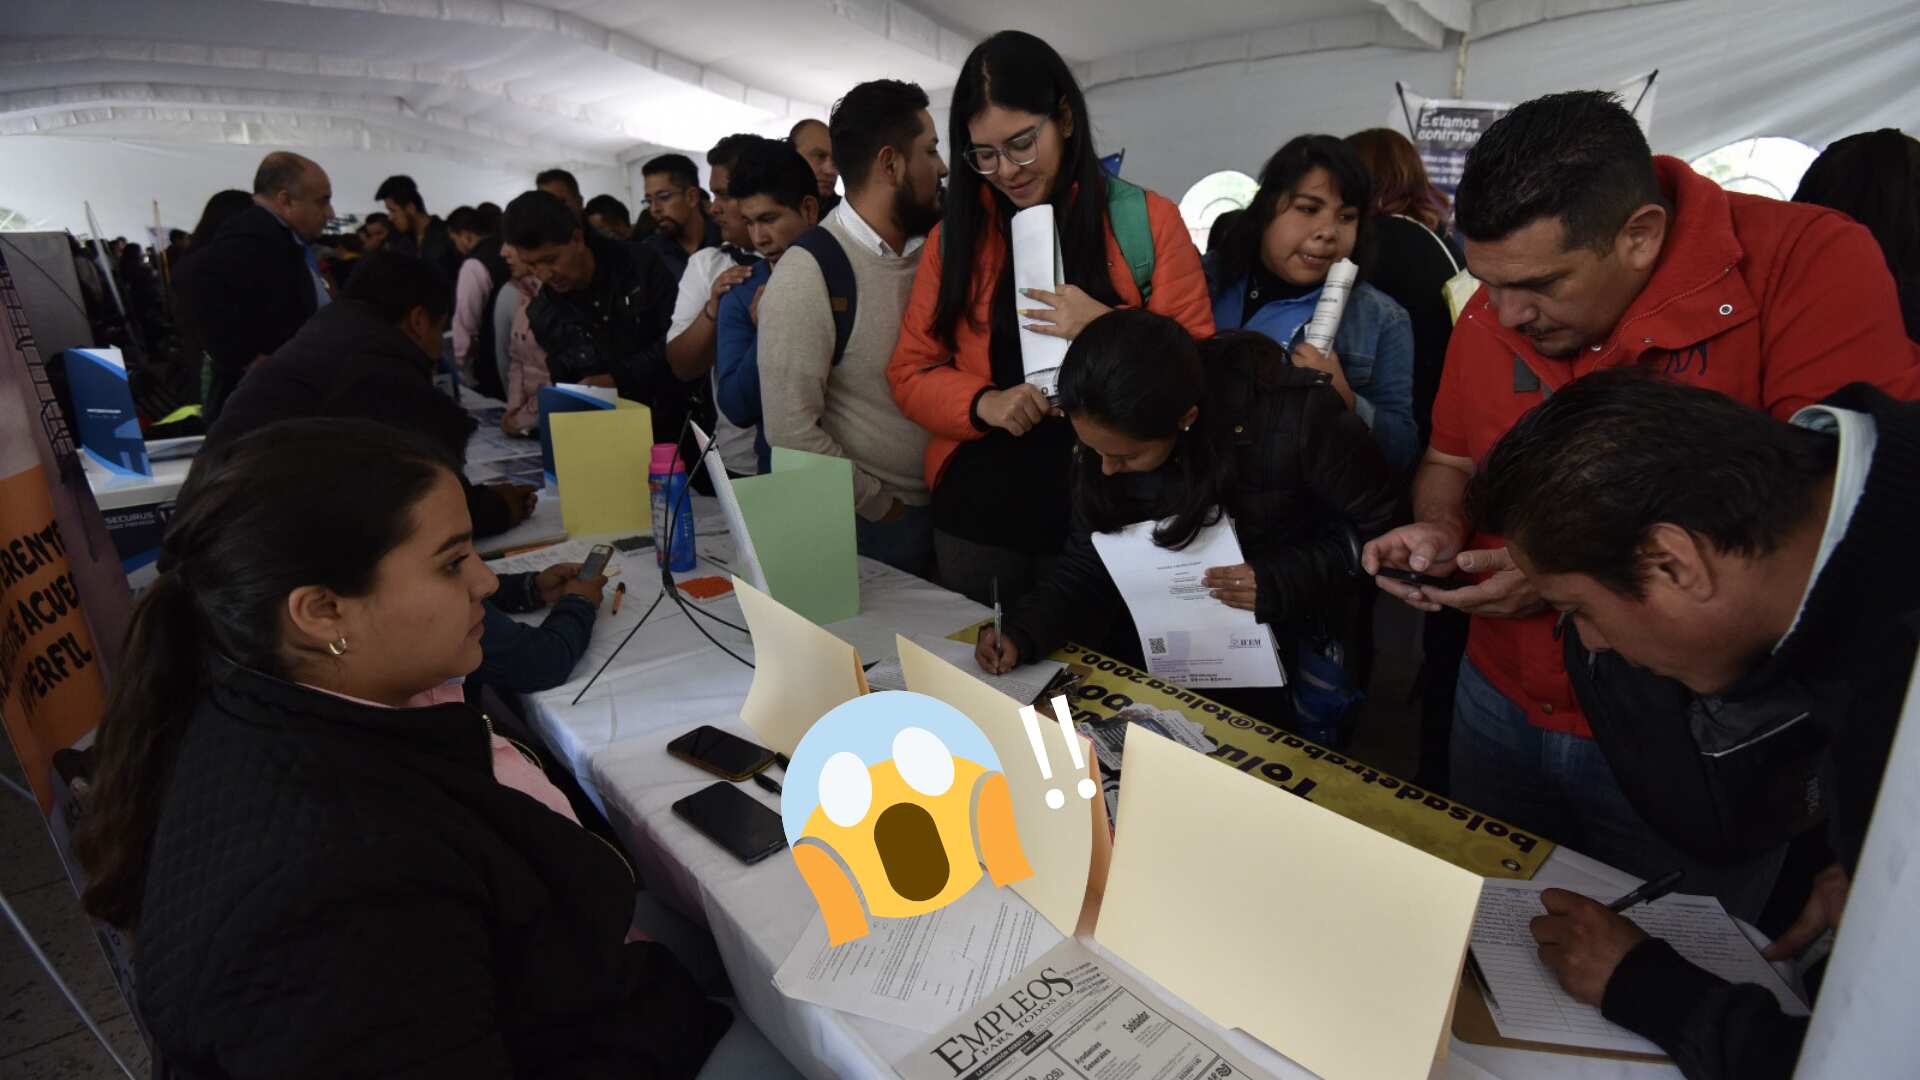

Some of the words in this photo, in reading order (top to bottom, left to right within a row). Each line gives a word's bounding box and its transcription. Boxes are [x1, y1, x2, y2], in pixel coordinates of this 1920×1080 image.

[1420, 110, 1480, 129] Estamos
[23, 631, 93, 708] ERFIL
[1062, 642, 1538, 853] bolsadetrabajo@toluca2000.c
[930, 967, 1074, 1078] EMPLEOS
[982, 1031, 1014, 1056] PARA
[1016, 998, 1057, 1029] TODOS
